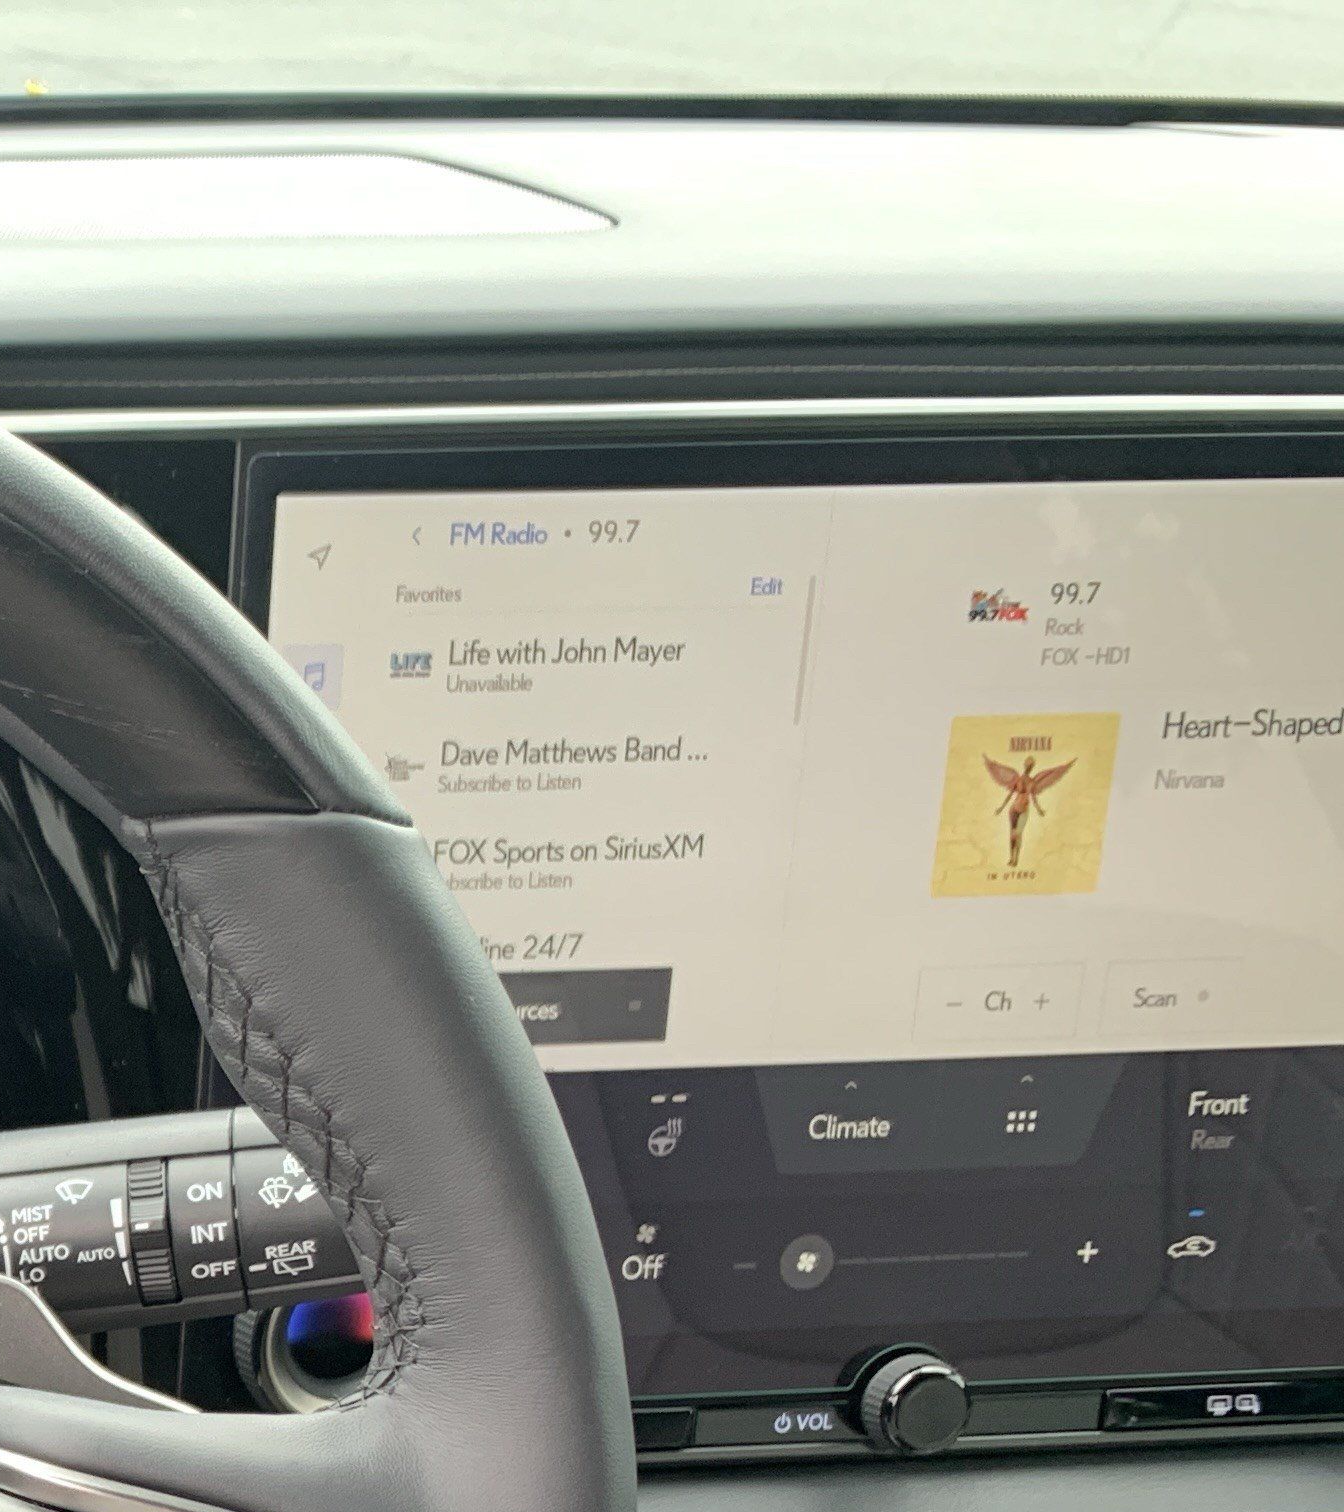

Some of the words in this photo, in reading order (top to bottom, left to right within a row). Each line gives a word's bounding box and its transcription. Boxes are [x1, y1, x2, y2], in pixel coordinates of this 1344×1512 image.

[450, 523, 485, 546] FM
[491, 522, 548, 546] Radio
[588, 520, 641, 544] 99.7
[395, 585, 462, 603] Favorites
[750, 576, 784, 596] Edit
[1050, 582, 1101, 605] 99.7
[1044, 618, 1084, 636] Rock
[448, 639, 490, 666] Life
[497, 638, 545, 664] with
[551, 637, 607, 664] John
[613, 636, 686, 667] Mayer
[1041, 648, 1078, 666] FOX
[446, 673, 533, 693] Unavailable
[441, 740, 499, 767] Dave
[505, 739, 617, 765] Matthews
[624, 737, 682, 763] Band
[437, 774, 511, 794] Subscribe
[516, 775, 532, 791] to
[537, 773, 582, 792] Listen
[1154, 769, 1225, 790] Nirvana
[433, 838, 487, 864] FOX
[493, 838, 564, 869] Sports
[570, 844, 598, 862] on
[604, 833, 705, 860] SiriusXM
[447, 873, 503, 890] bscribe
[508, 874, 523, 889] to
[528, 872, 573, 889] Listen
[522, 932, 584, 960] 24/7
[984, 990, 1013, 1012] Ch
[1133, 988, 1178, 1009] Scan
[1188, 1090, 1251, 1118] Front
[808, 1114, 892, 1142] Climate
[1190, 1129, 1234, 1150] Rear
[186, 1181, 223, 1203] ON
[12, 1204, 54, 1226] MIST
[13, 1225, 51, 1245] OFF
[190, 1222, 229, 1246] INT
[18, 1244, 70, 1264] AUTO
[76, 1247, 116, 1264] AUTO
[264, 1240, 318, 1259] REAR
[19, 1267, 46, 1286] LO
[191, 1260, 237, 1280] OFF
[621, 1254, 666, 1282] Off
[797, 1412, 833, 1432] VOL
